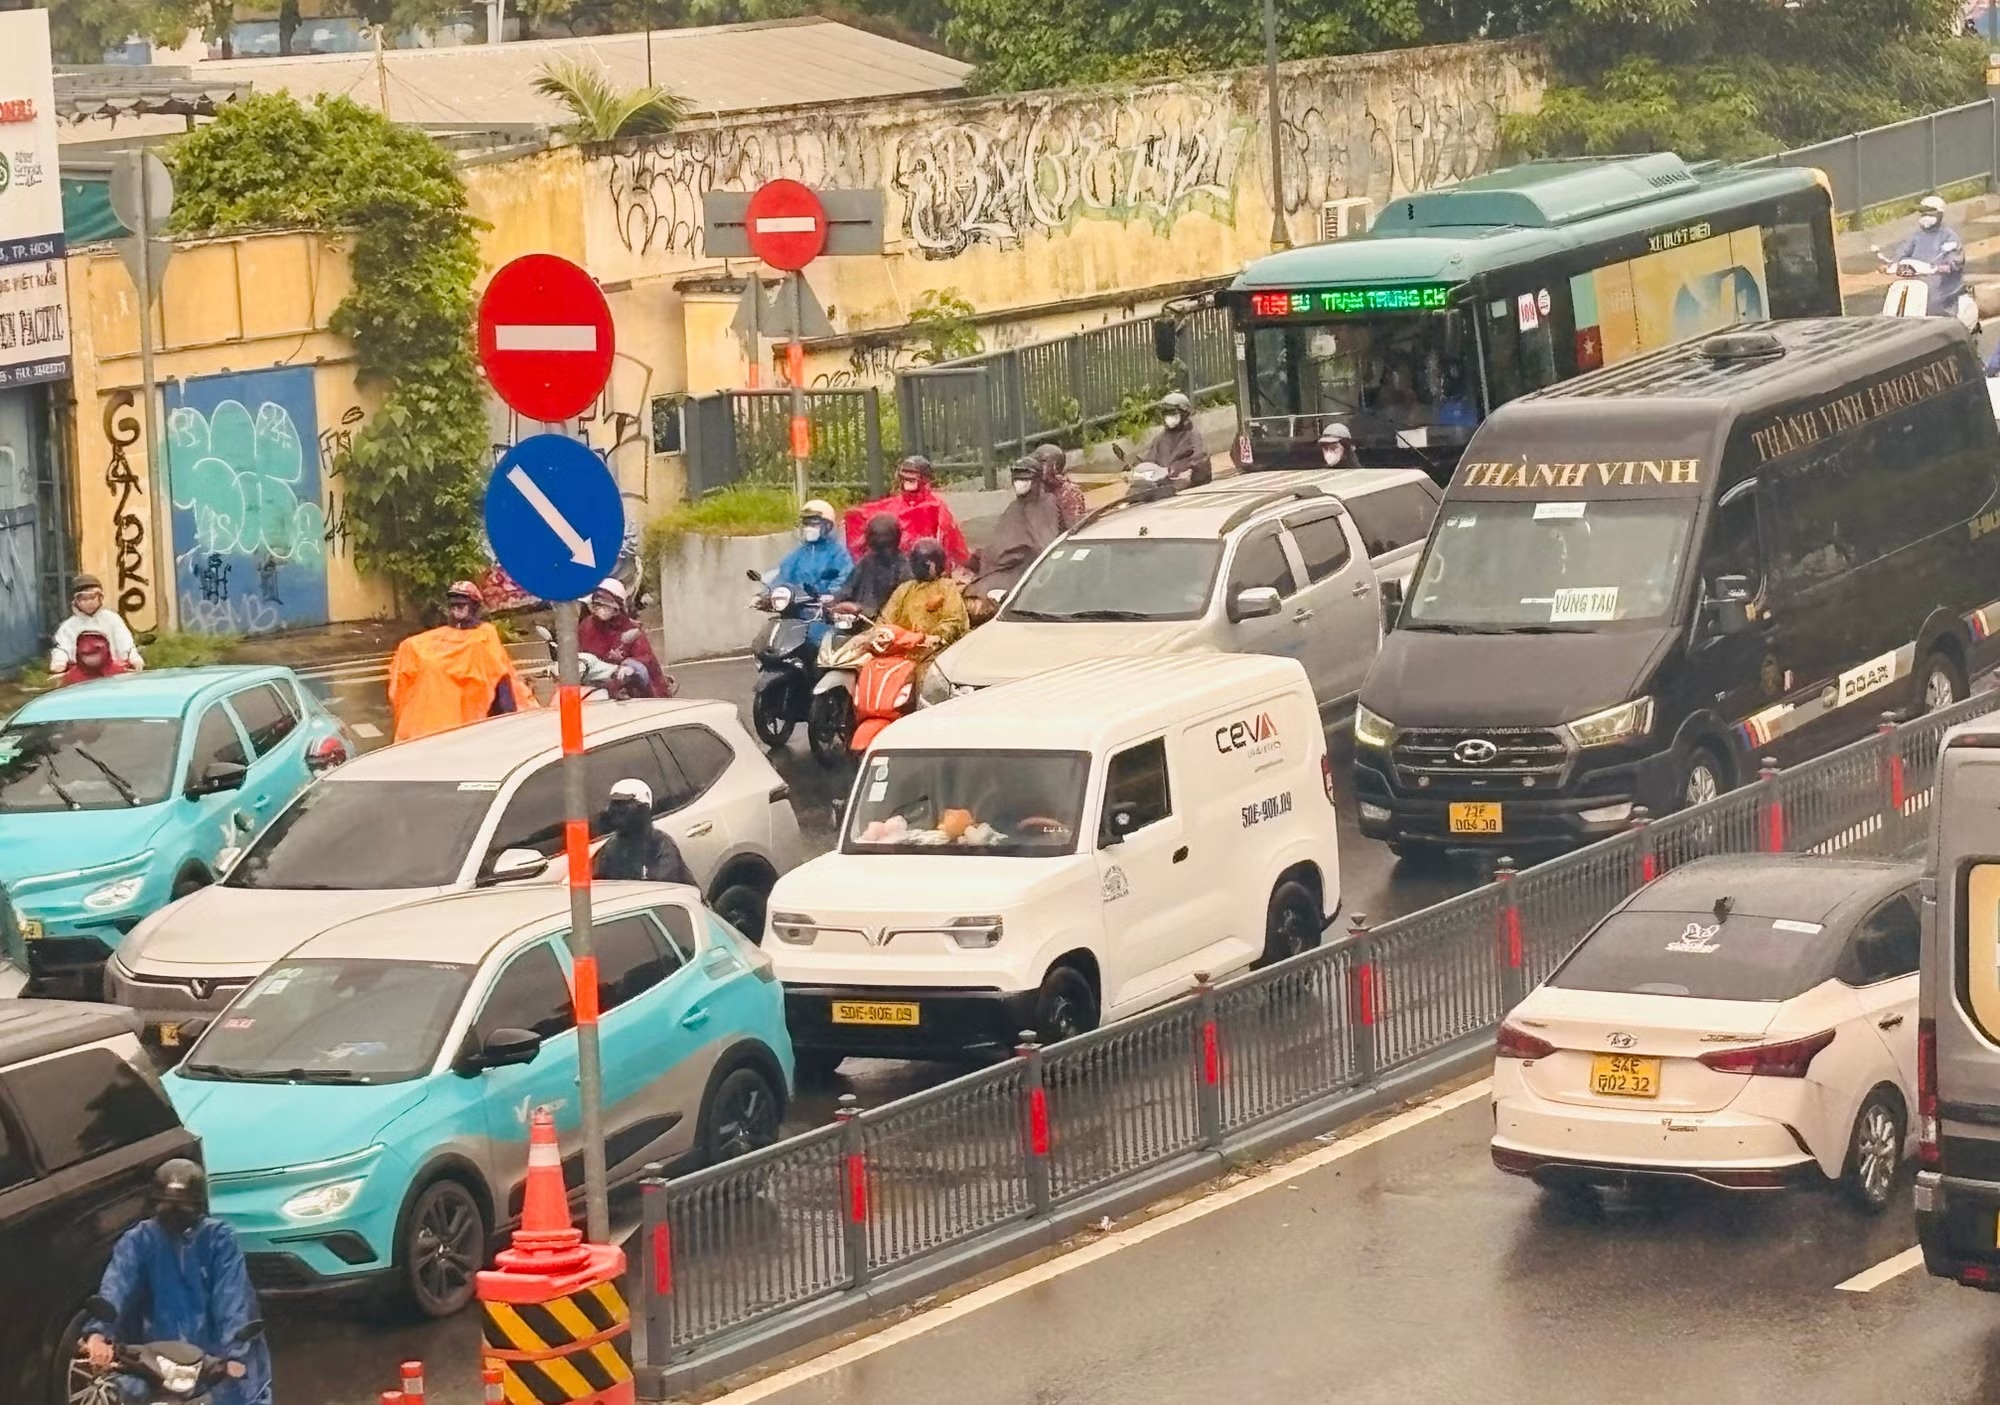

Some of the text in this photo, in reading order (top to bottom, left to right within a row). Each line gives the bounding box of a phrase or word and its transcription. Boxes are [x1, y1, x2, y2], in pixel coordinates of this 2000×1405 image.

[1751, 355, 1963, 462] THÀNH VINH LIMOUSINE
[1463, 453, 1701, 488] THÀNH VINH
